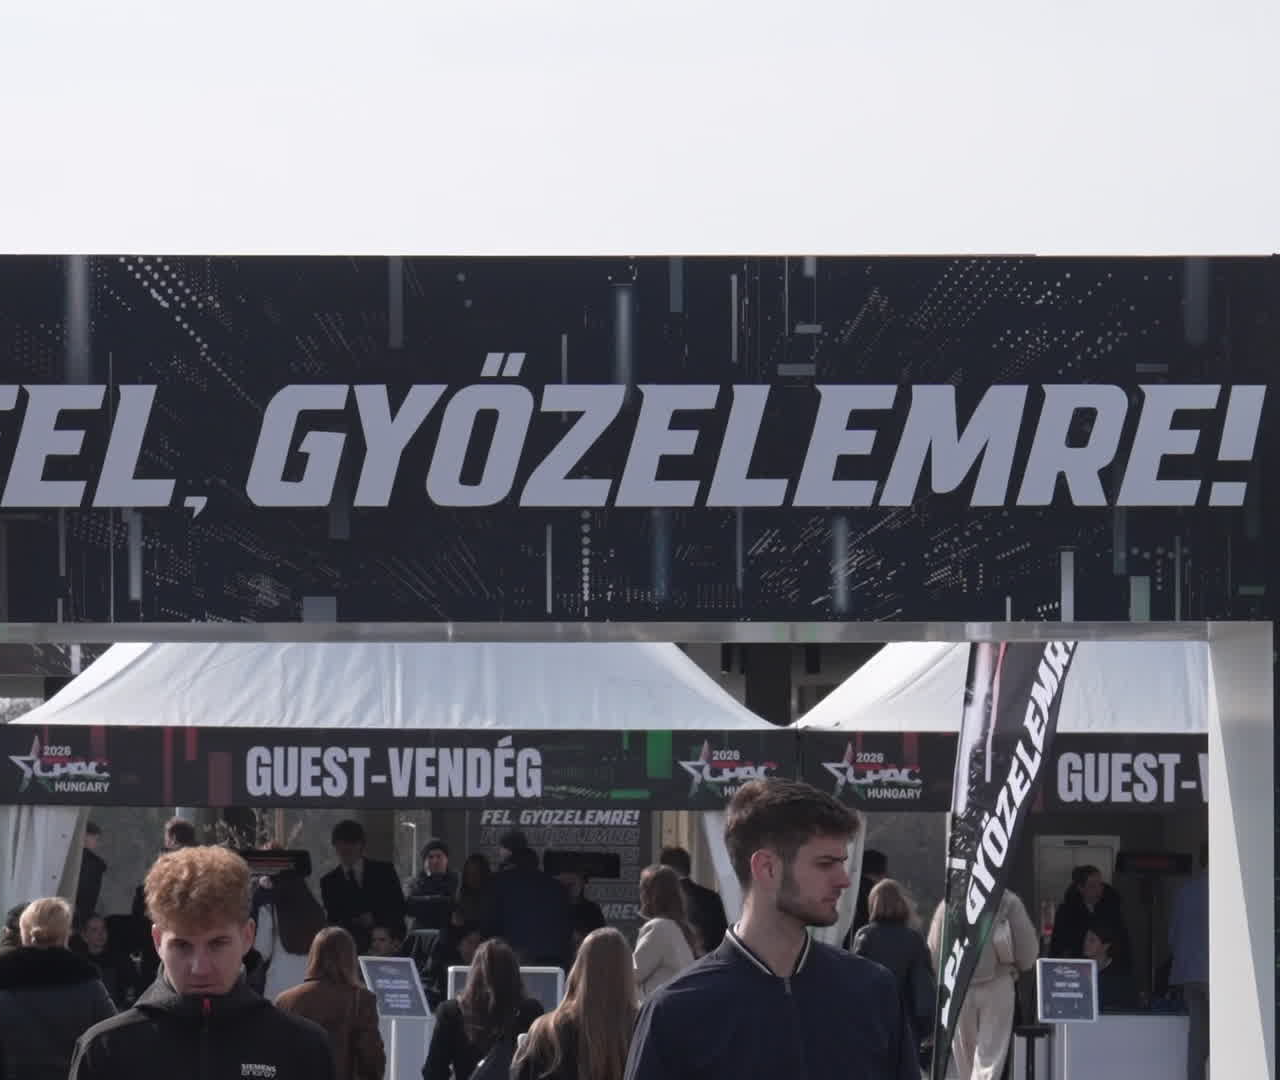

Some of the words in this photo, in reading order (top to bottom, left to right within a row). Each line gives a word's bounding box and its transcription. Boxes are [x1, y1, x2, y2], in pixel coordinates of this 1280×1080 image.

[245, 352, 1267, 507] GYŐZELEMRE!
[712, 751, 740, 761] 2026
[856, 753, 884, 763] 2026
[246, 736, 542, 798] GUEST-VENDÉG
[55, 782, 110, 793] HUNGARY
[867, 788, 922, 799] HUNGARY
